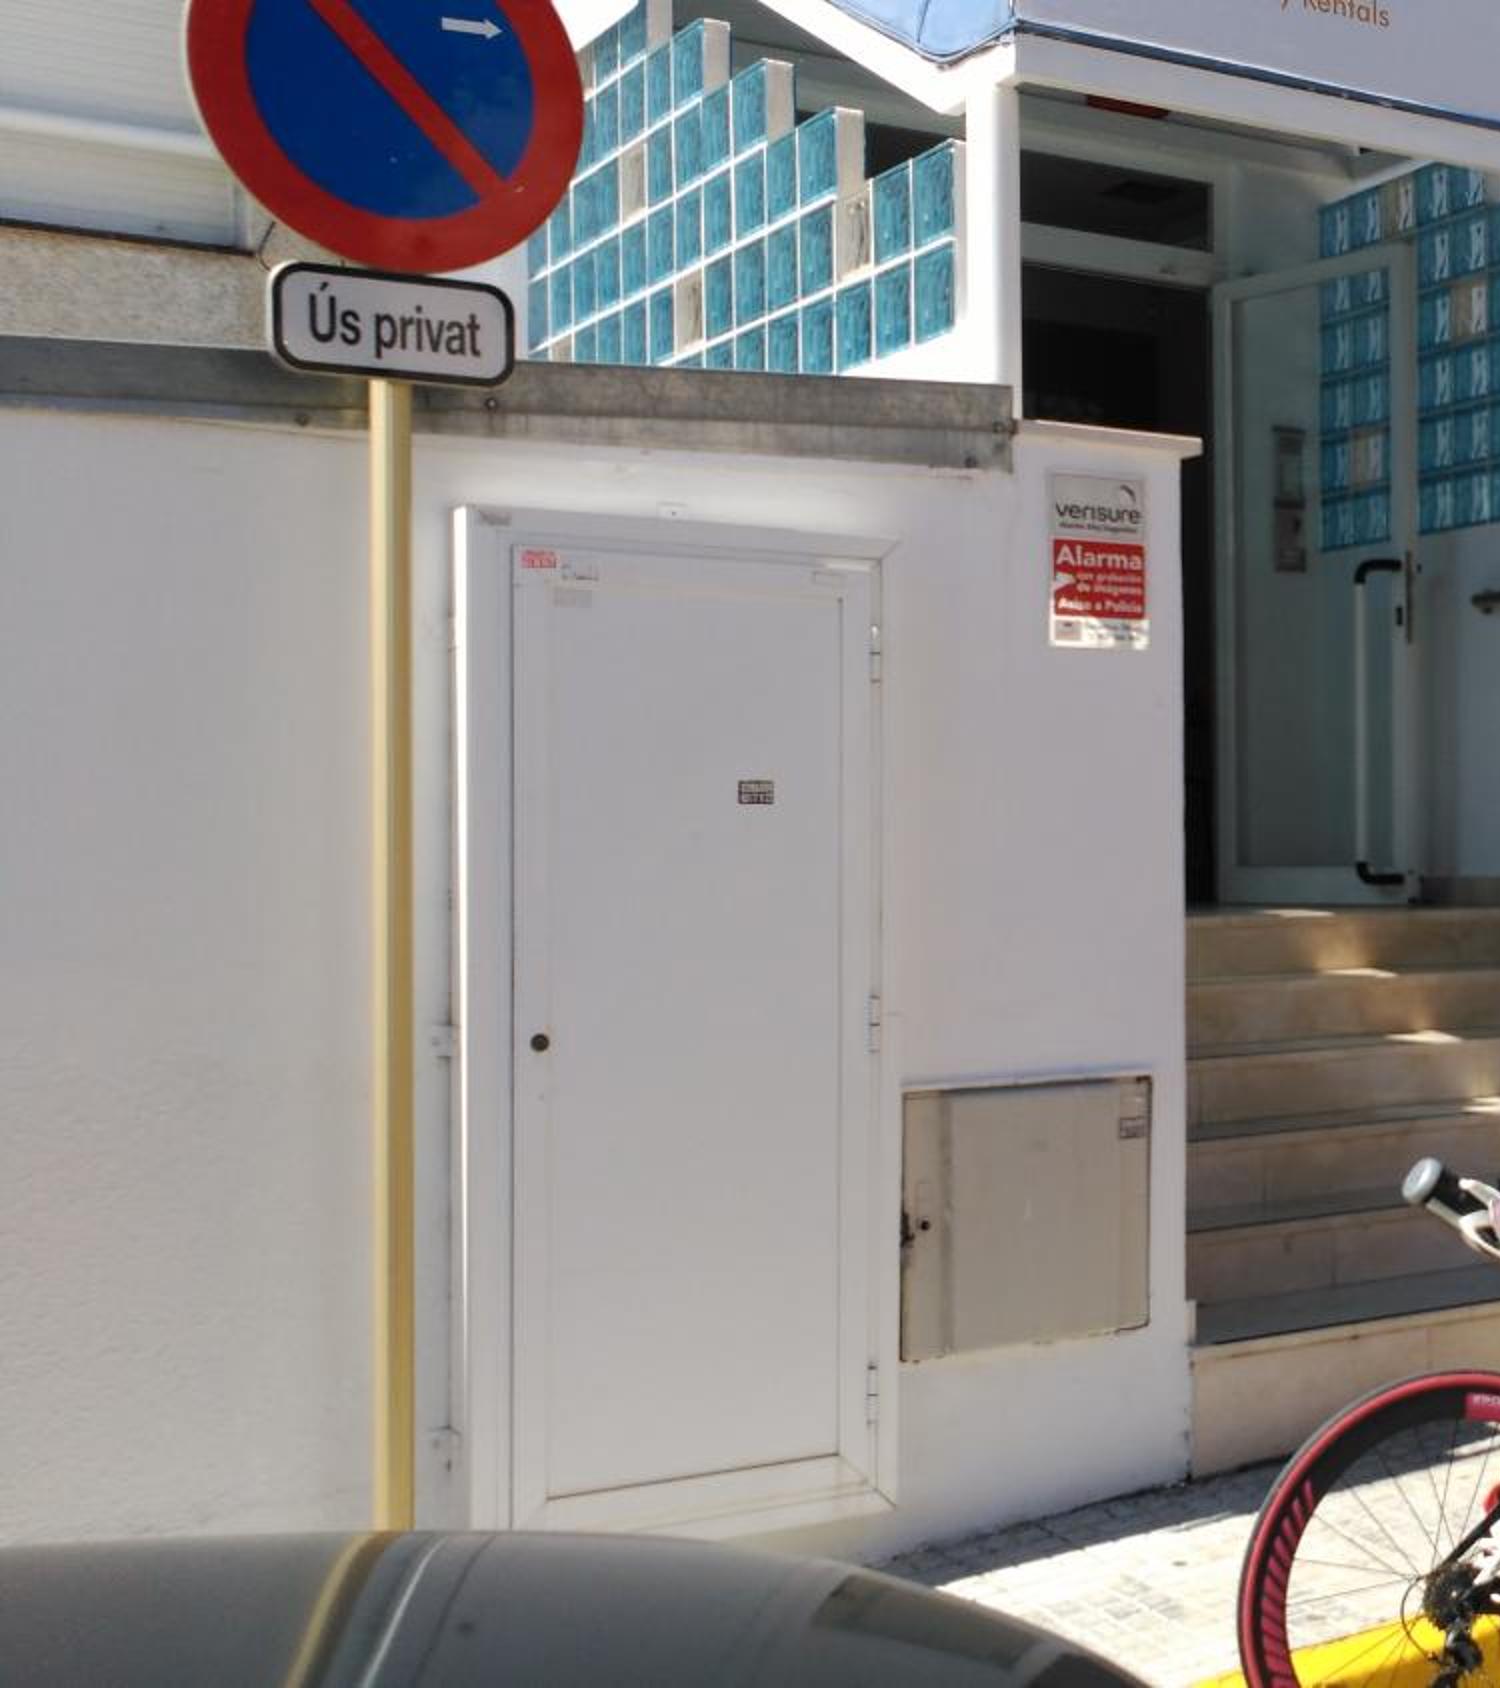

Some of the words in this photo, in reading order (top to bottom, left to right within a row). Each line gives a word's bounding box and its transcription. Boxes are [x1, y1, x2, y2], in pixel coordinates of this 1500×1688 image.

[308, 280, 361, 347] Ús
[374, 304, 481, 360] privat
[1055, 502, 1142, 525] verisure
[1056, 544, 1142, 570] Alarma
